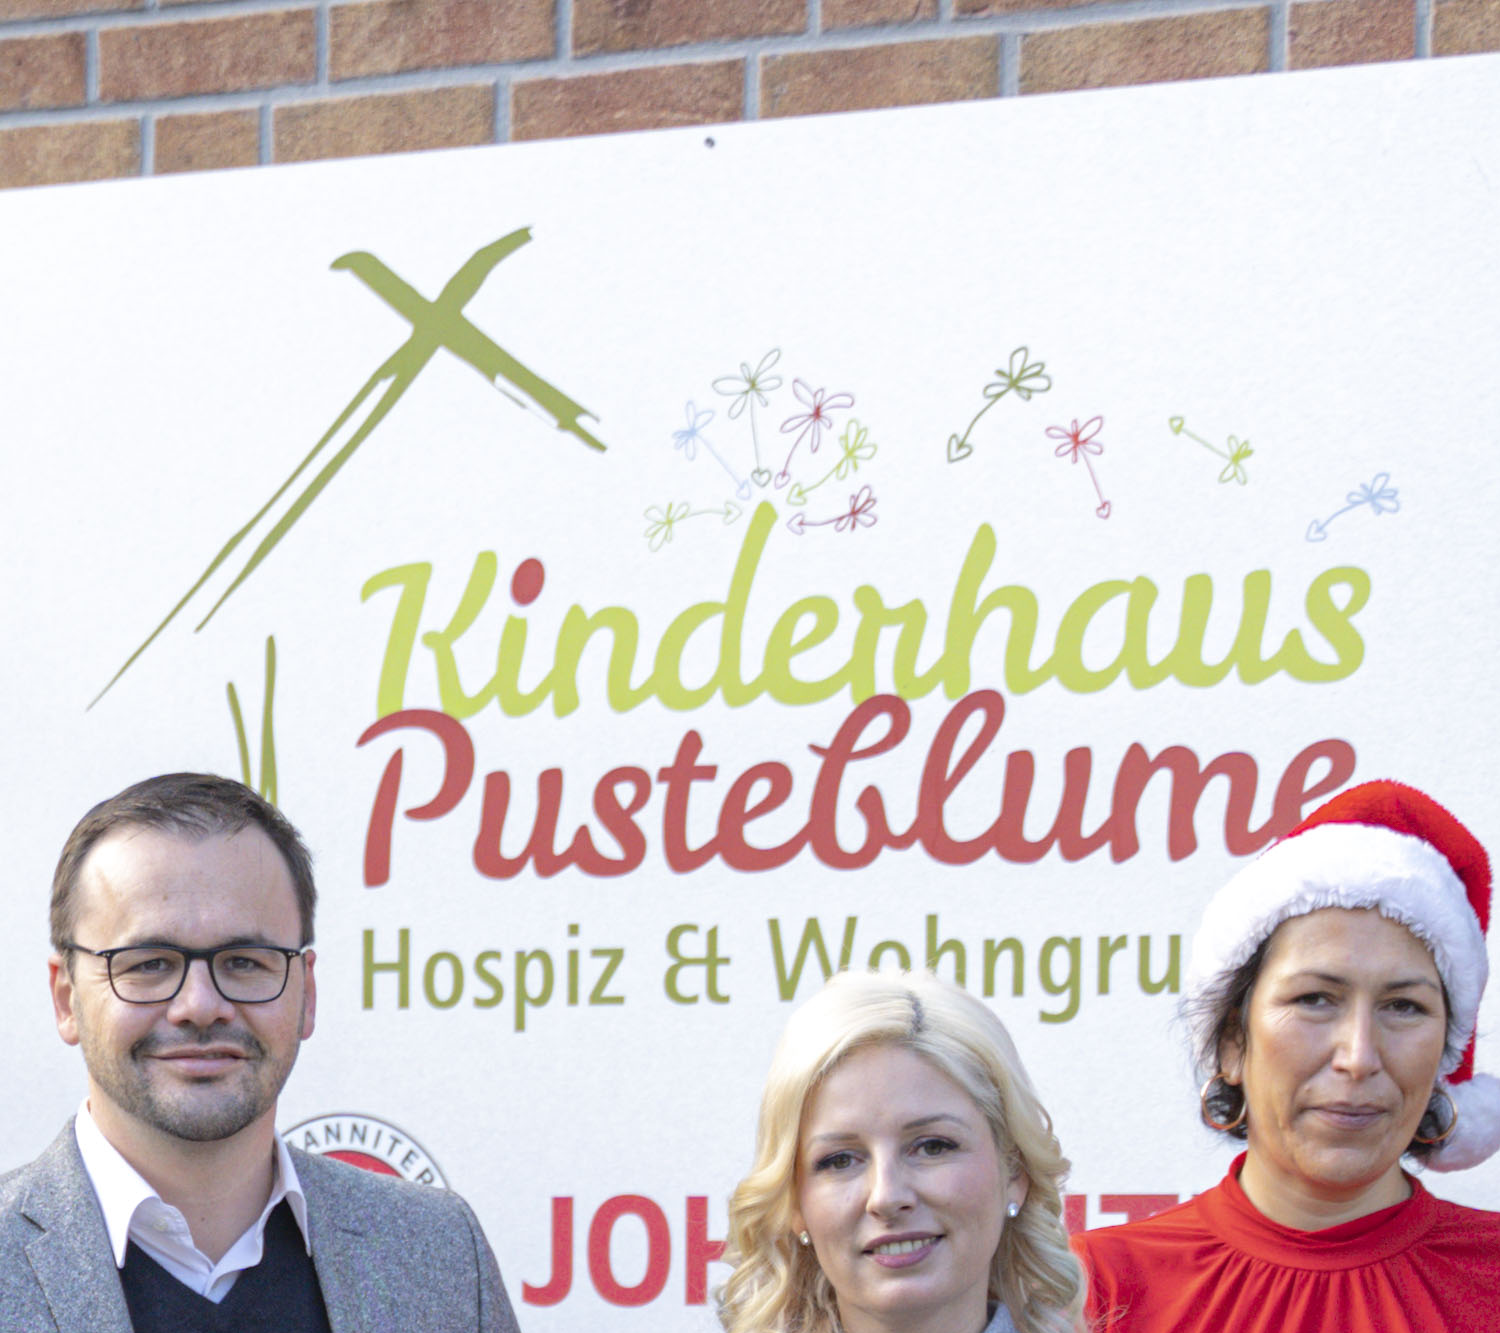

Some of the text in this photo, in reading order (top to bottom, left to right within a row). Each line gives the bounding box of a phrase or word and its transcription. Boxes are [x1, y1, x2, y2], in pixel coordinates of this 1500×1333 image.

[361, 501, 1371, 719] Kinderhaus
[356, 689, 1357, 888] Pusteblume
[361, 914, 1181, 1031] Hospiz & Wohngru
